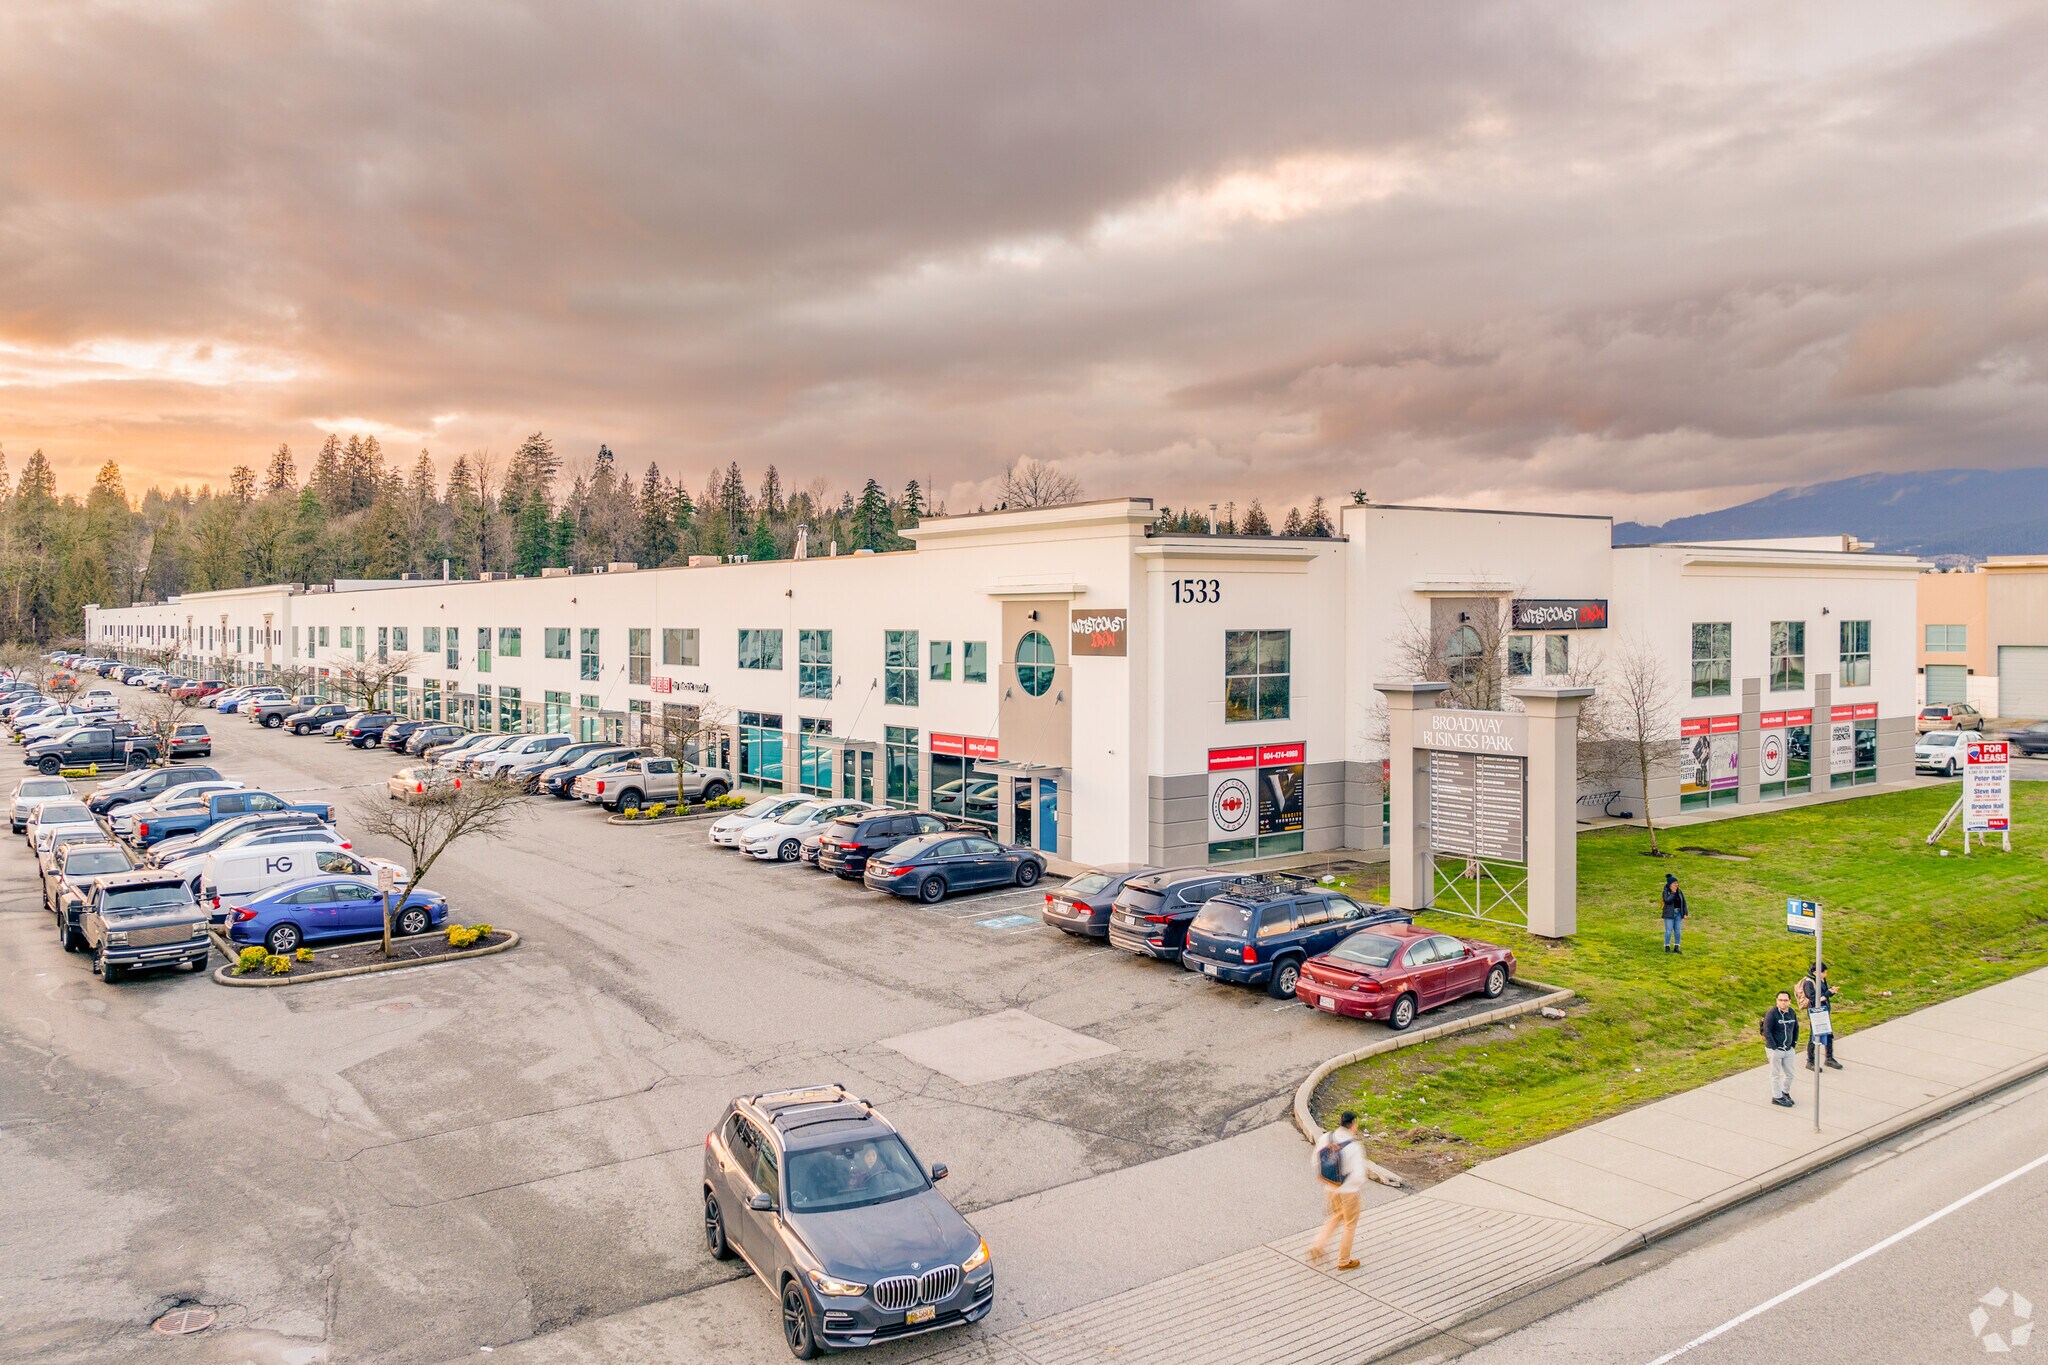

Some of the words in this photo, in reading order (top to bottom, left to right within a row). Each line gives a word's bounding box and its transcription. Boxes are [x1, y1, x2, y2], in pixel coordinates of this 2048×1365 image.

[1171, 579, 1220, 603] 1533
[1432, 715, 1503, 734] BROADWAY
[1423, 731, 1478, 749] BUSINESS
[1482, 735, 1514, 751] PARK
[1983, 745, 2002, 753] FOR
[1979, 753, 2007, 763] LEASE
[1216, 783, 1229, 798] WEST
[1231, 781, 1248, 795] COAST
[1223, 821, 1242, 830] IRON
[266, 856, 293, 874] HG
[1790, 901, 1799, 913] T
